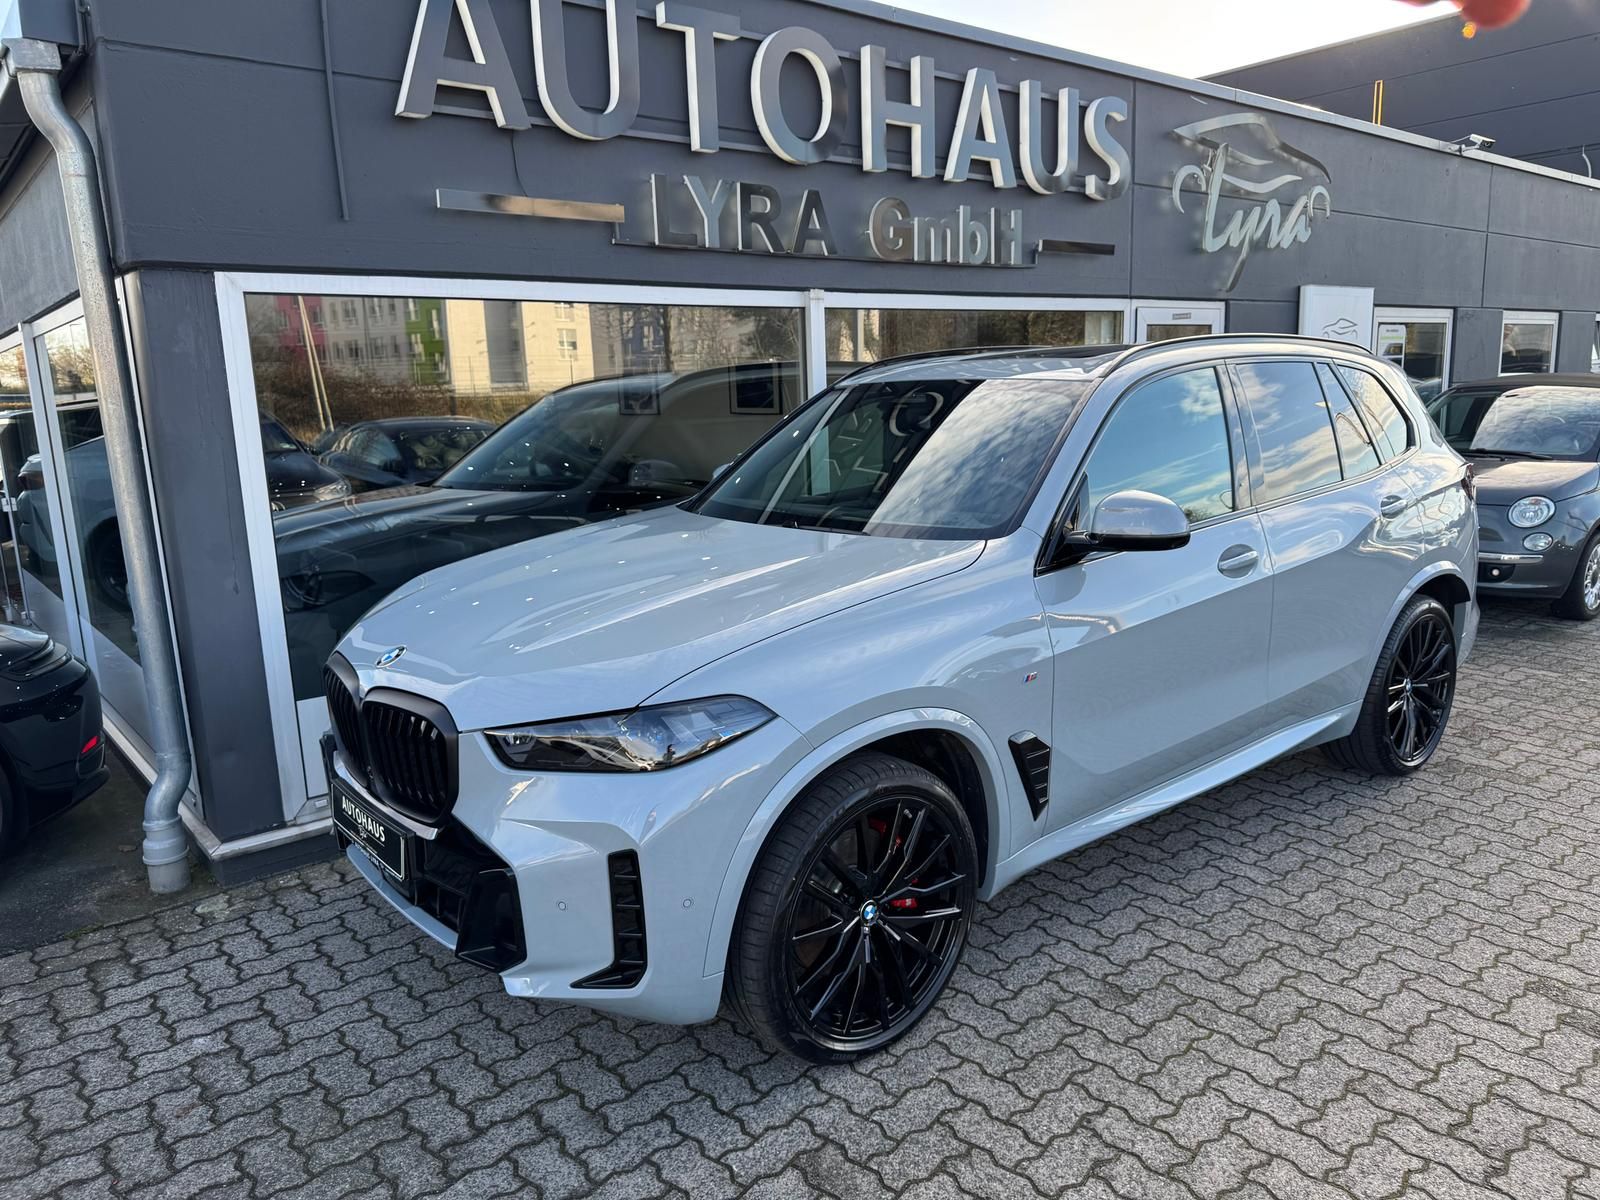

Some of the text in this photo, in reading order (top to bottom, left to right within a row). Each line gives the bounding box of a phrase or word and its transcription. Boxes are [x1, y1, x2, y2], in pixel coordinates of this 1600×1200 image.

[394, 0, 1130, 201] AUTOHAUS
[651, 173, 1023, 265] LYRA GmbH
[342, 795, 386, 842] AUTOHAUS
